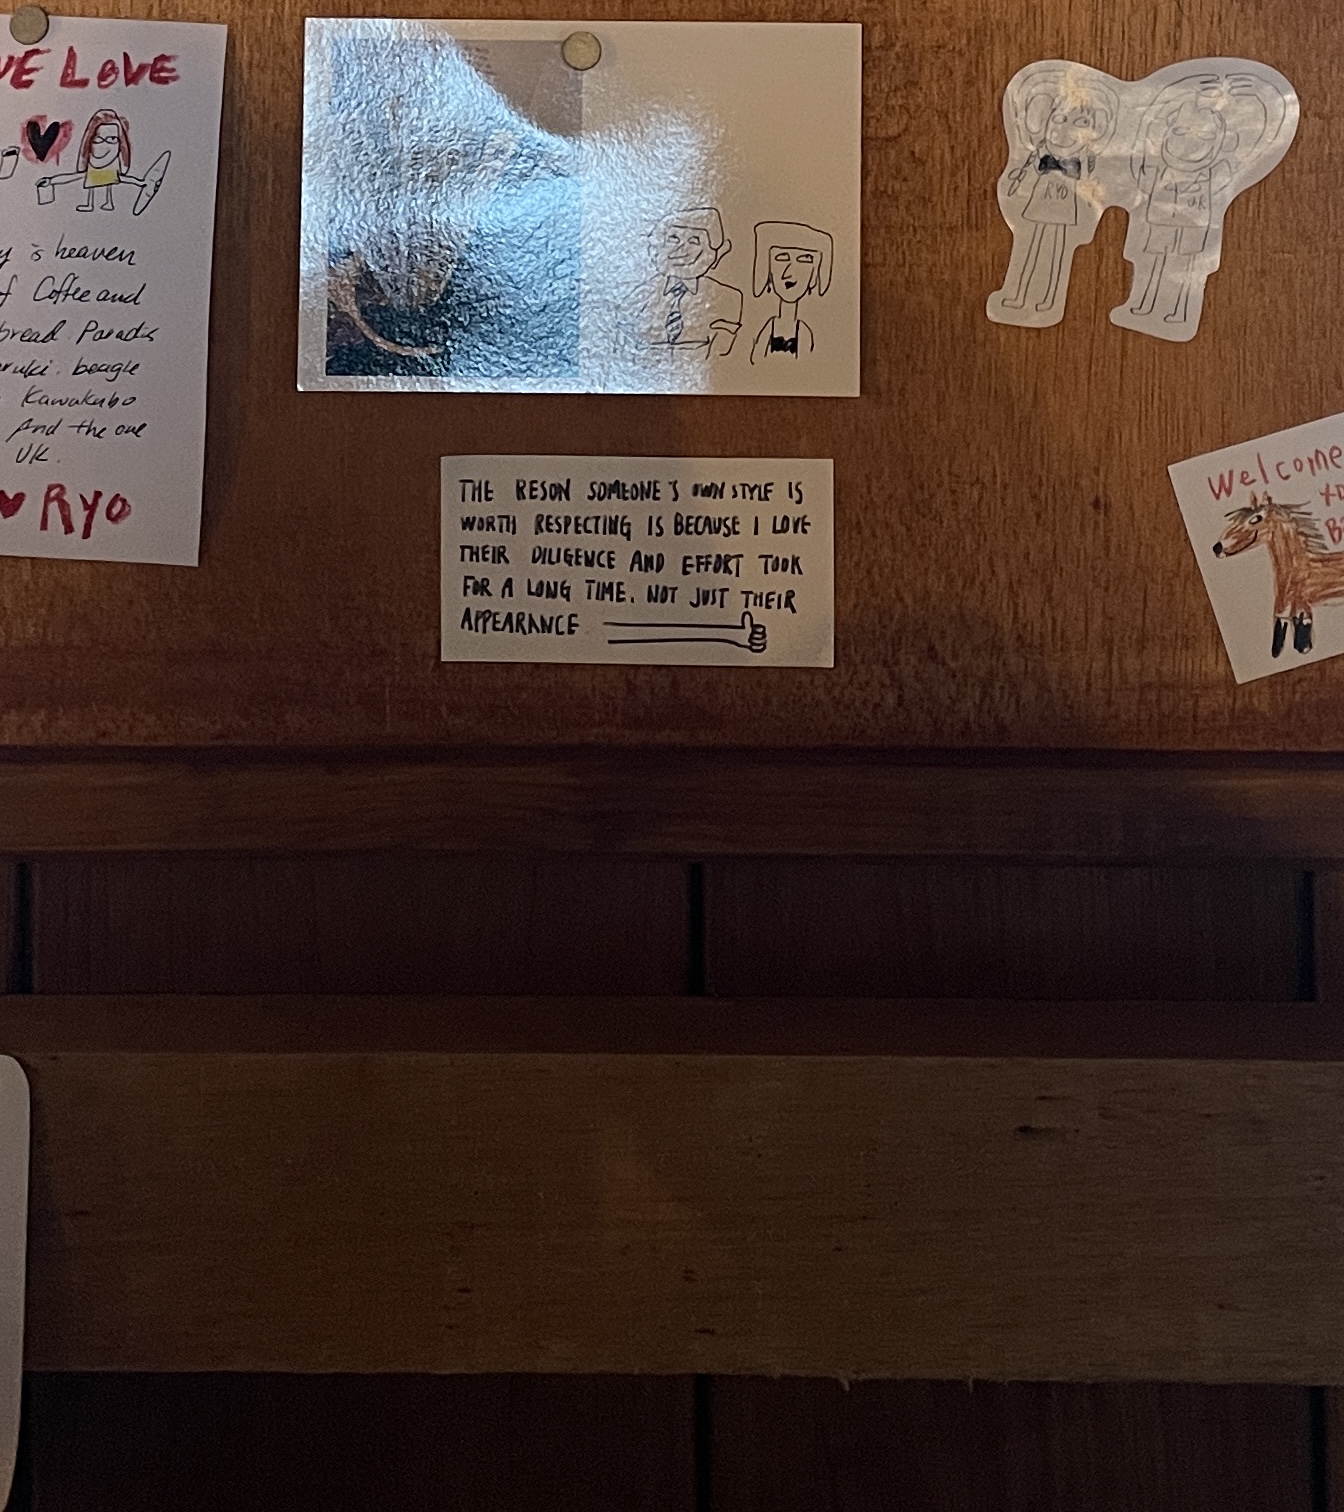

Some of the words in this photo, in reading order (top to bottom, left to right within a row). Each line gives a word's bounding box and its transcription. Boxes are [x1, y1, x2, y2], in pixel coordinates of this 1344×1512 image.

[60, 46, 180, 89] LOVE
[31, 243, 44, 262] is
[55, 238, 135, 266] heaven
[33, 276, 91, 305] Coffee
[96, 287, 143, 305] and
[76, 320, 159, 345] Paradis
[72, 358, 140, 380] beagle
[21, 386, 136, 409] Kawakubo
[7, 418, 63, 440] And
[69, 420, 106, 439] the
[115, 423, 147, 437] one
[1207, 442, 1344, 502] Welcome
[459, 479, 493, 502] THE
[516, 478, 570, 501] RESON
[692, 482, 725, 499] OWN
[732, 482, 774, 501] STYLE
[788, 482, 803, 504] IS
[461, 515, 516, 535] WORTH
[535, 514, 631, 541] RESPECTING
[648, 516, 664, 537] IS
[674, 512, 740, 537] BECAUSE
[751, 515, 760, 535] I
[772, 515, 811, 534] LOVE
[460, 545, 509, 564] THEIR
[532, 546, 615, 569] DILIGENCE
[630, 550, 664, 573] AND
[682, 554, 743, 577] EFFORT
[758, 554, 803, 575] TOOK
[463, 576, 492, 597] FOR
[501, 578, 513, 598] A
[527, 579, 571, 602] LONG
[585, 580, 634, 604] TIME.
[647, 585, 678, 604] NOT
[689, 587, 729, 608] JUST
[741, 590, 796, 614] THEIR
[461, 607, 579, 635] APPEARANCE
